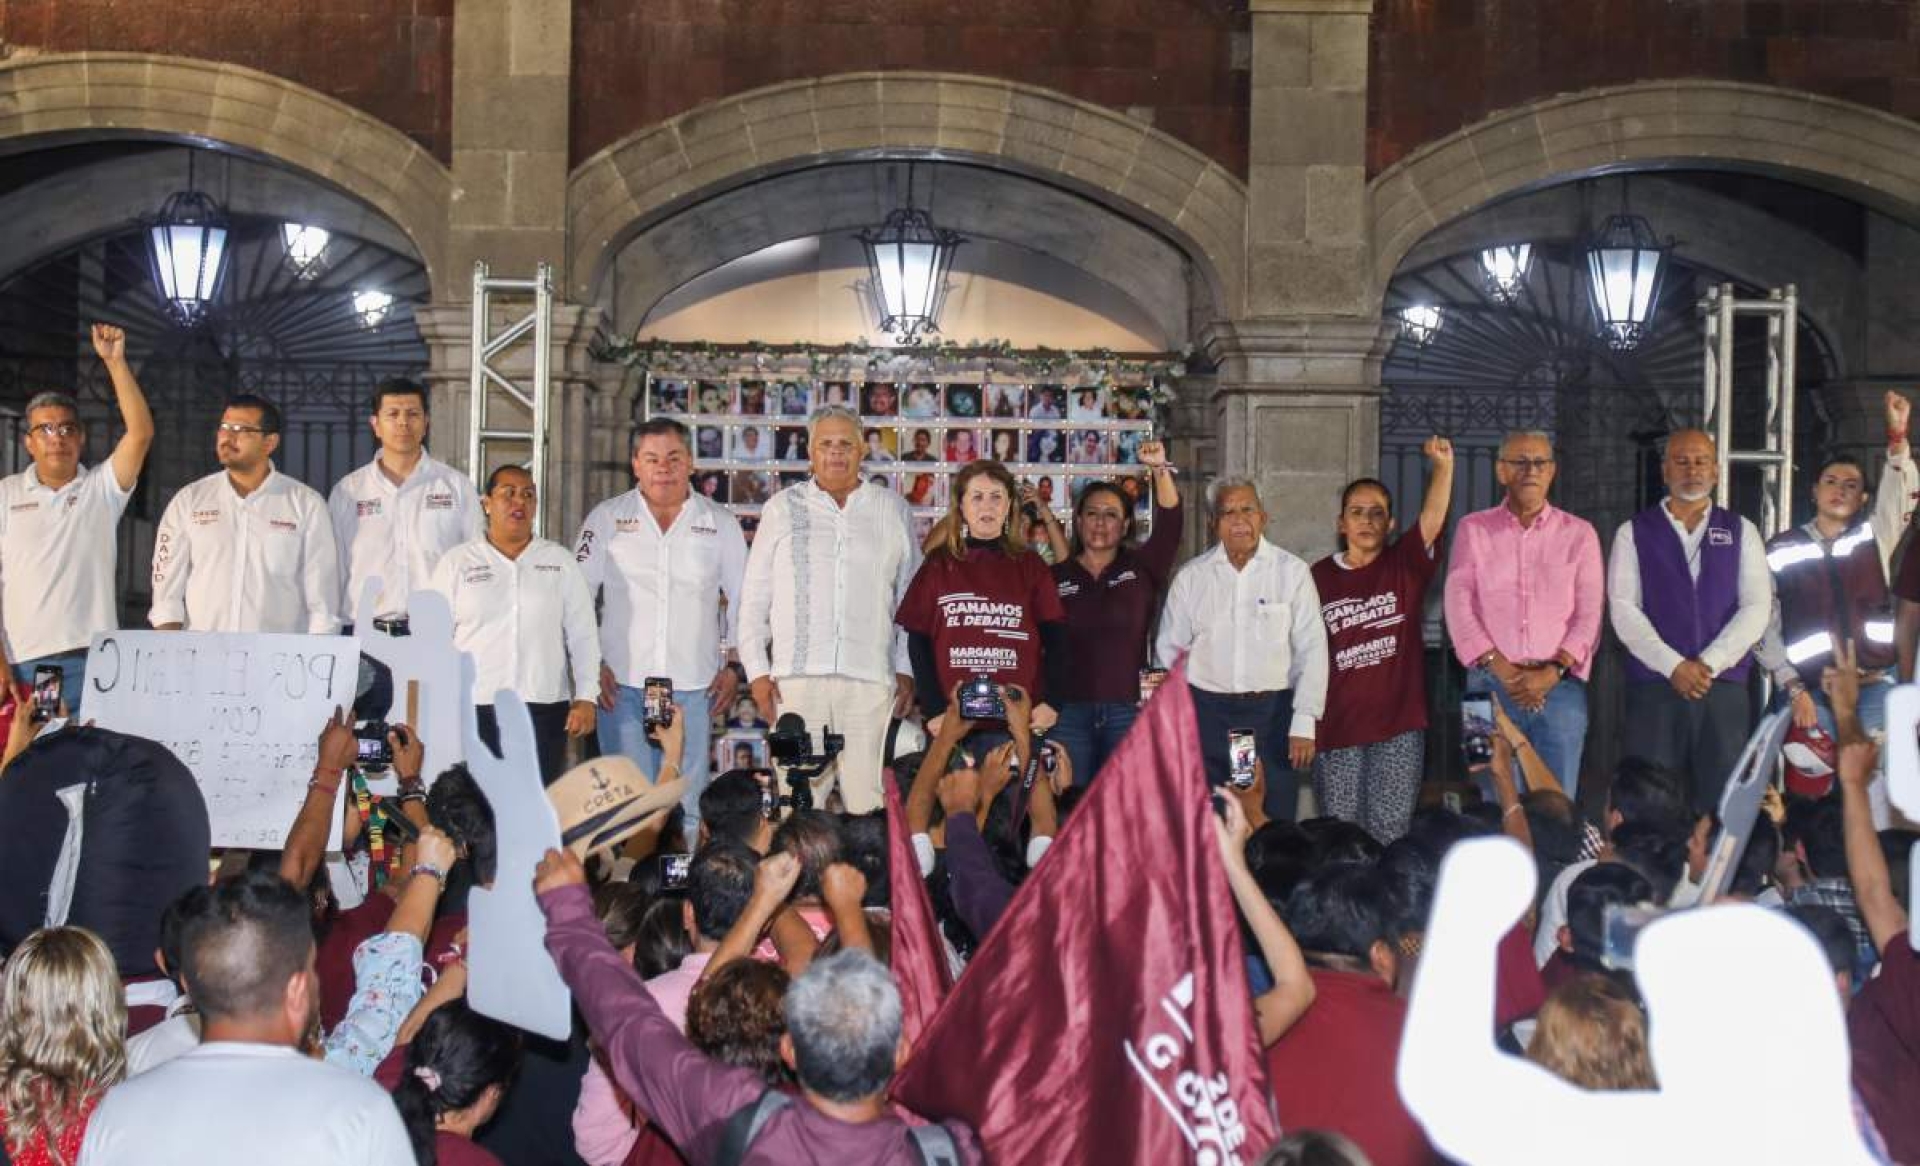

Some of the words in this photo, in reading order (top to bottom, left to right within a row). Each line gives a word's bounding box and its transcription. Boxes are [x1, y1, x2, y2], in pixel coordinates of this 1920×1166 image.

[154, 533, 170, 583] DAVID
[942, 602, 1024, 618] ¡GANAMOS
[946, 615, 961, 628] EL
[963, 615, 1022, 628] DEBATE!
[949, 647, 1018, 660] MARGARITA
[949, 658, 1017, 667] GOBERNADORA
